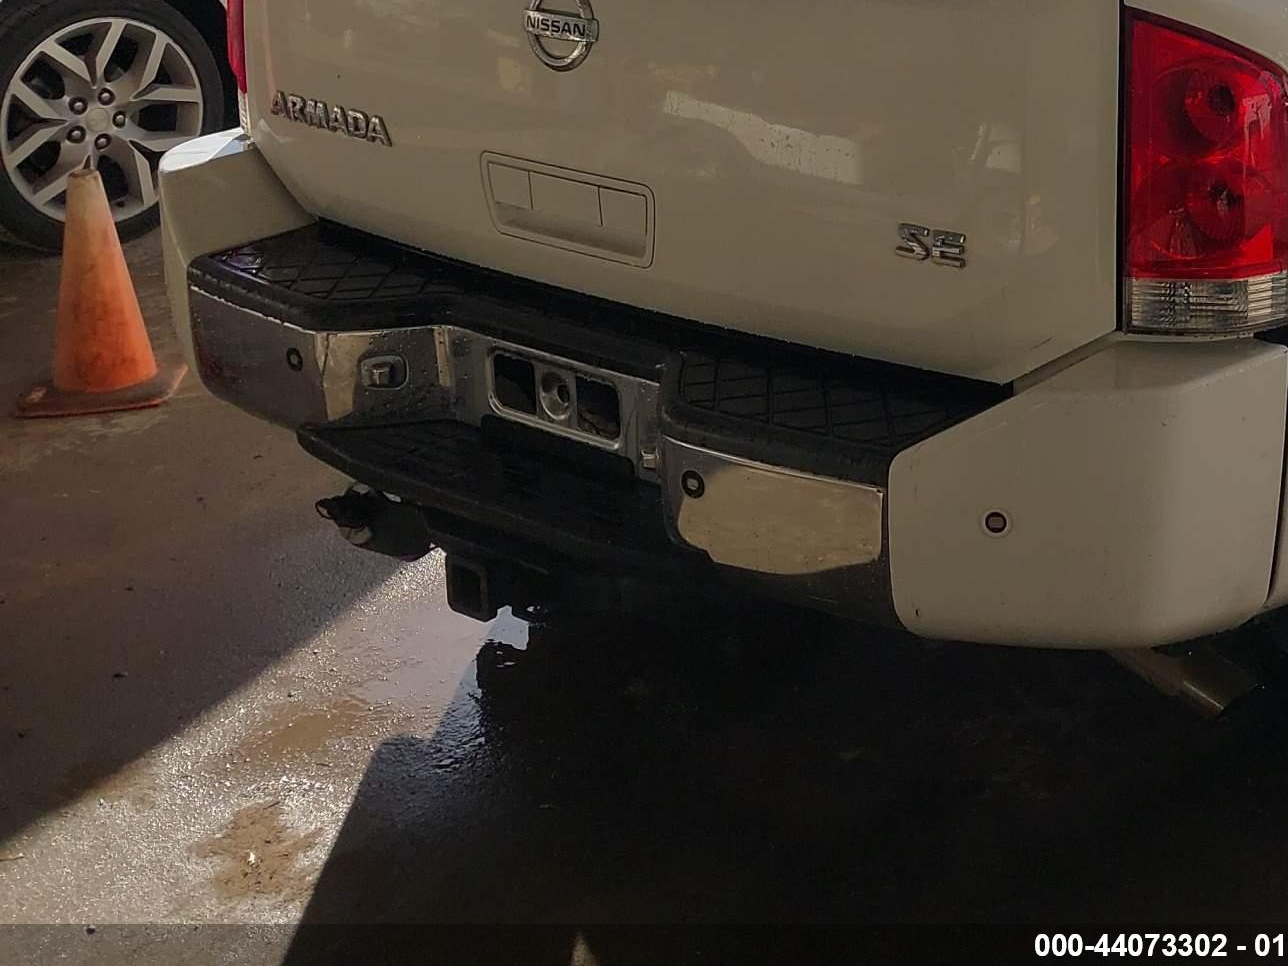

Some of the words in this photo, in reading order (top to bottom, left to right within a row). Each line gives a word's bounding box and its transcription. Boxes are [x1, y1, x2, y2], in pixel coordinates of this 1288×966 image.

[526, 15, 586, 37] NISSAN
[271, 90, 393, 147] ARMADA
[895, 222, 967, 269] SE
